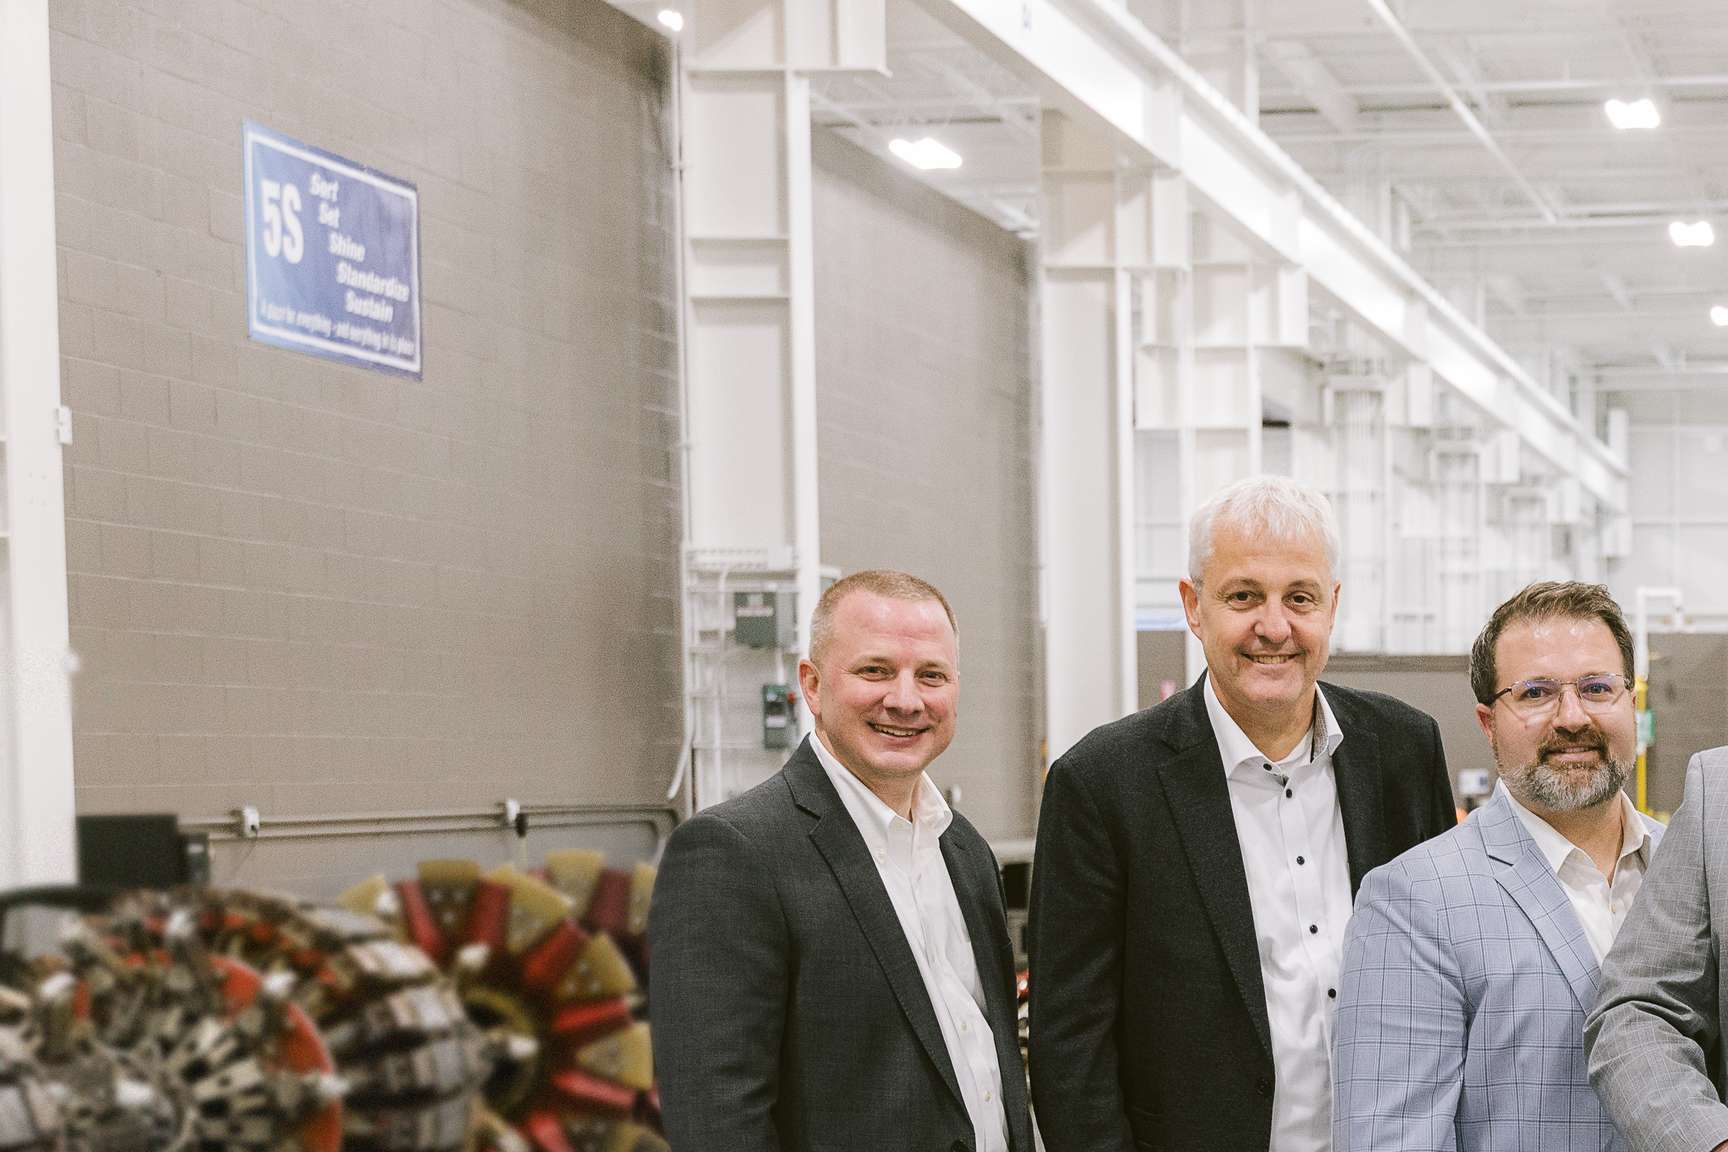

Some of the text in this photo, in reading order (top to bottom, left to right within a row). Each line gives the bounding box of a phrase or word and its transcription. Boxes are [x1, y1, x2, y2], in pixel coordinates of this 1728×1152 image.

[261, 178, 304, 265] 5S
[328, 231, 366, 263] Shine
[335, 260, 410, 303] Standardize
[345, 288, 394, 324] Sustain
